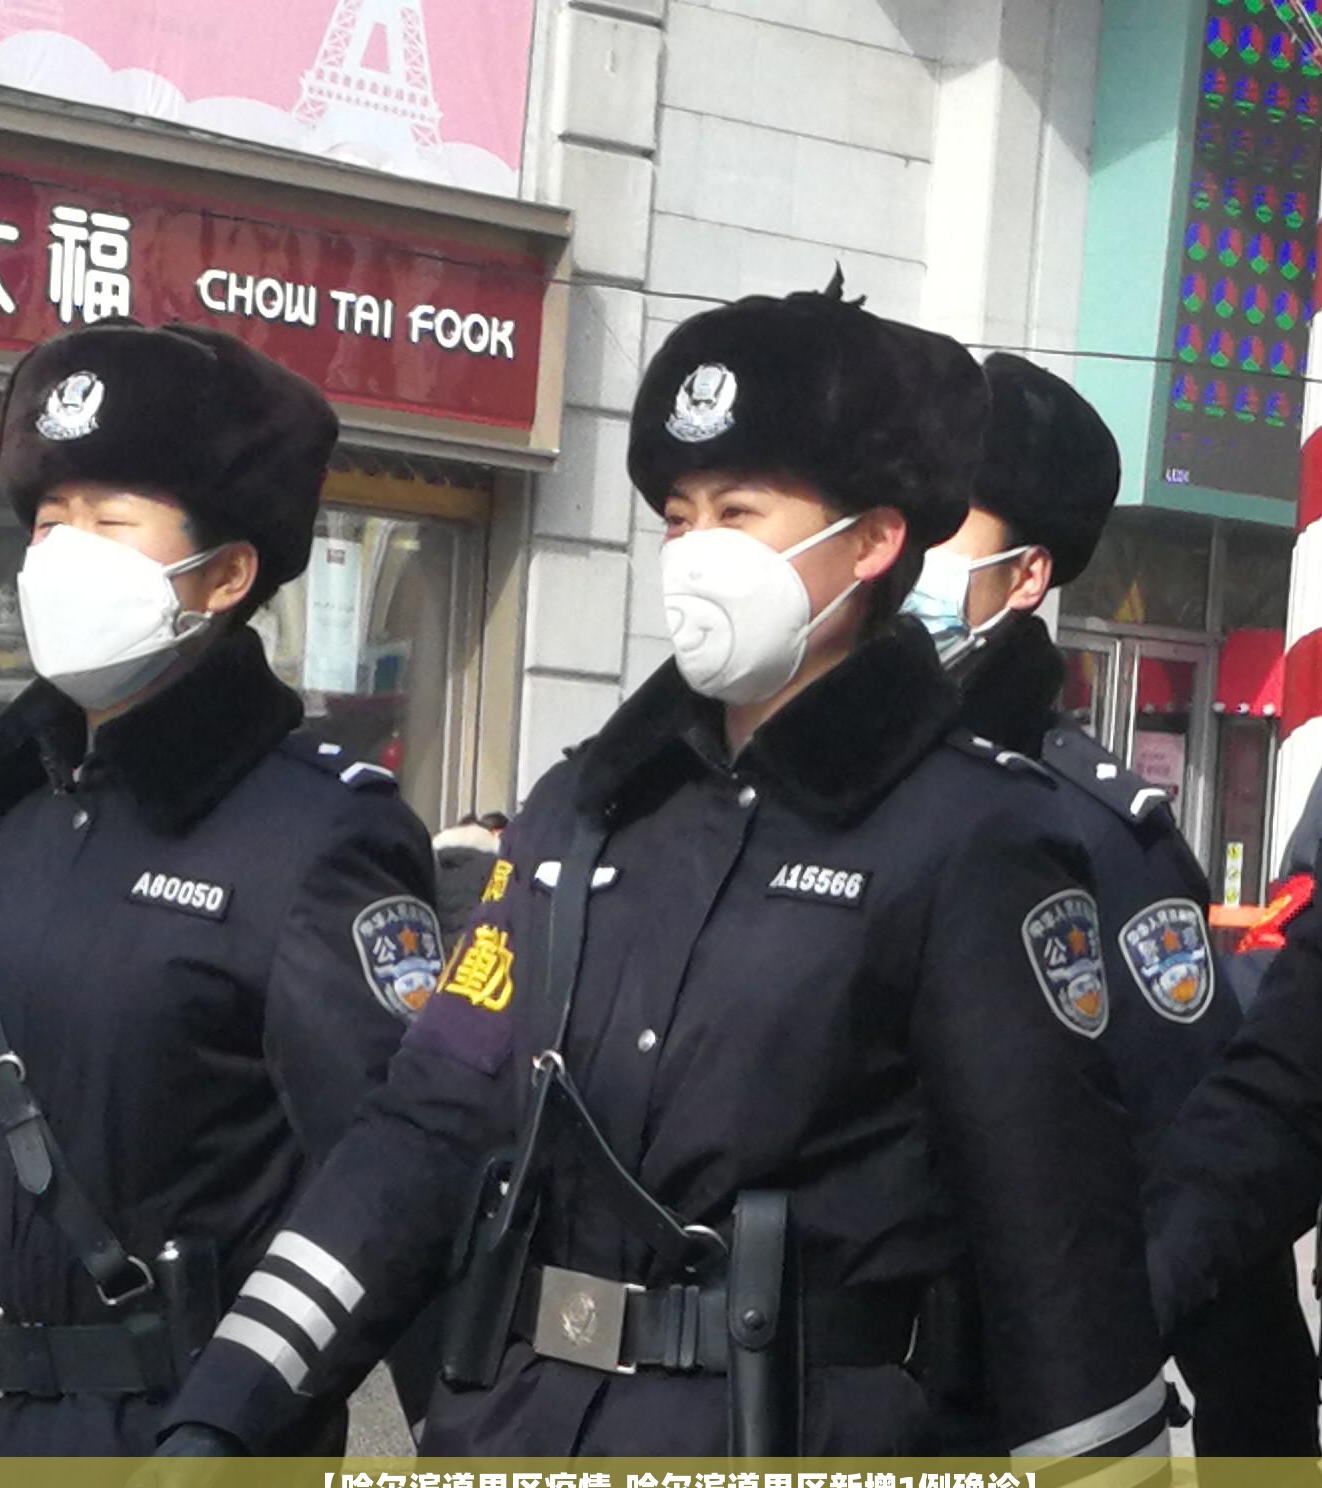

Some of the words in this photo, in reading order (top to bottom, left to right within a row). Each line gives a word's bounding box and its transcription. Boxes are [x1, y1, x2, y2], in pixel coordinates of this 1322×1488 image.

[195, 268, 316, 328] CHOW
[329, 289, 394, 340] TAI
[408, 304, 517, 359] FOOK
[132, 871, 224, 911] A80050
[769, 863, 863, 899] A15566
